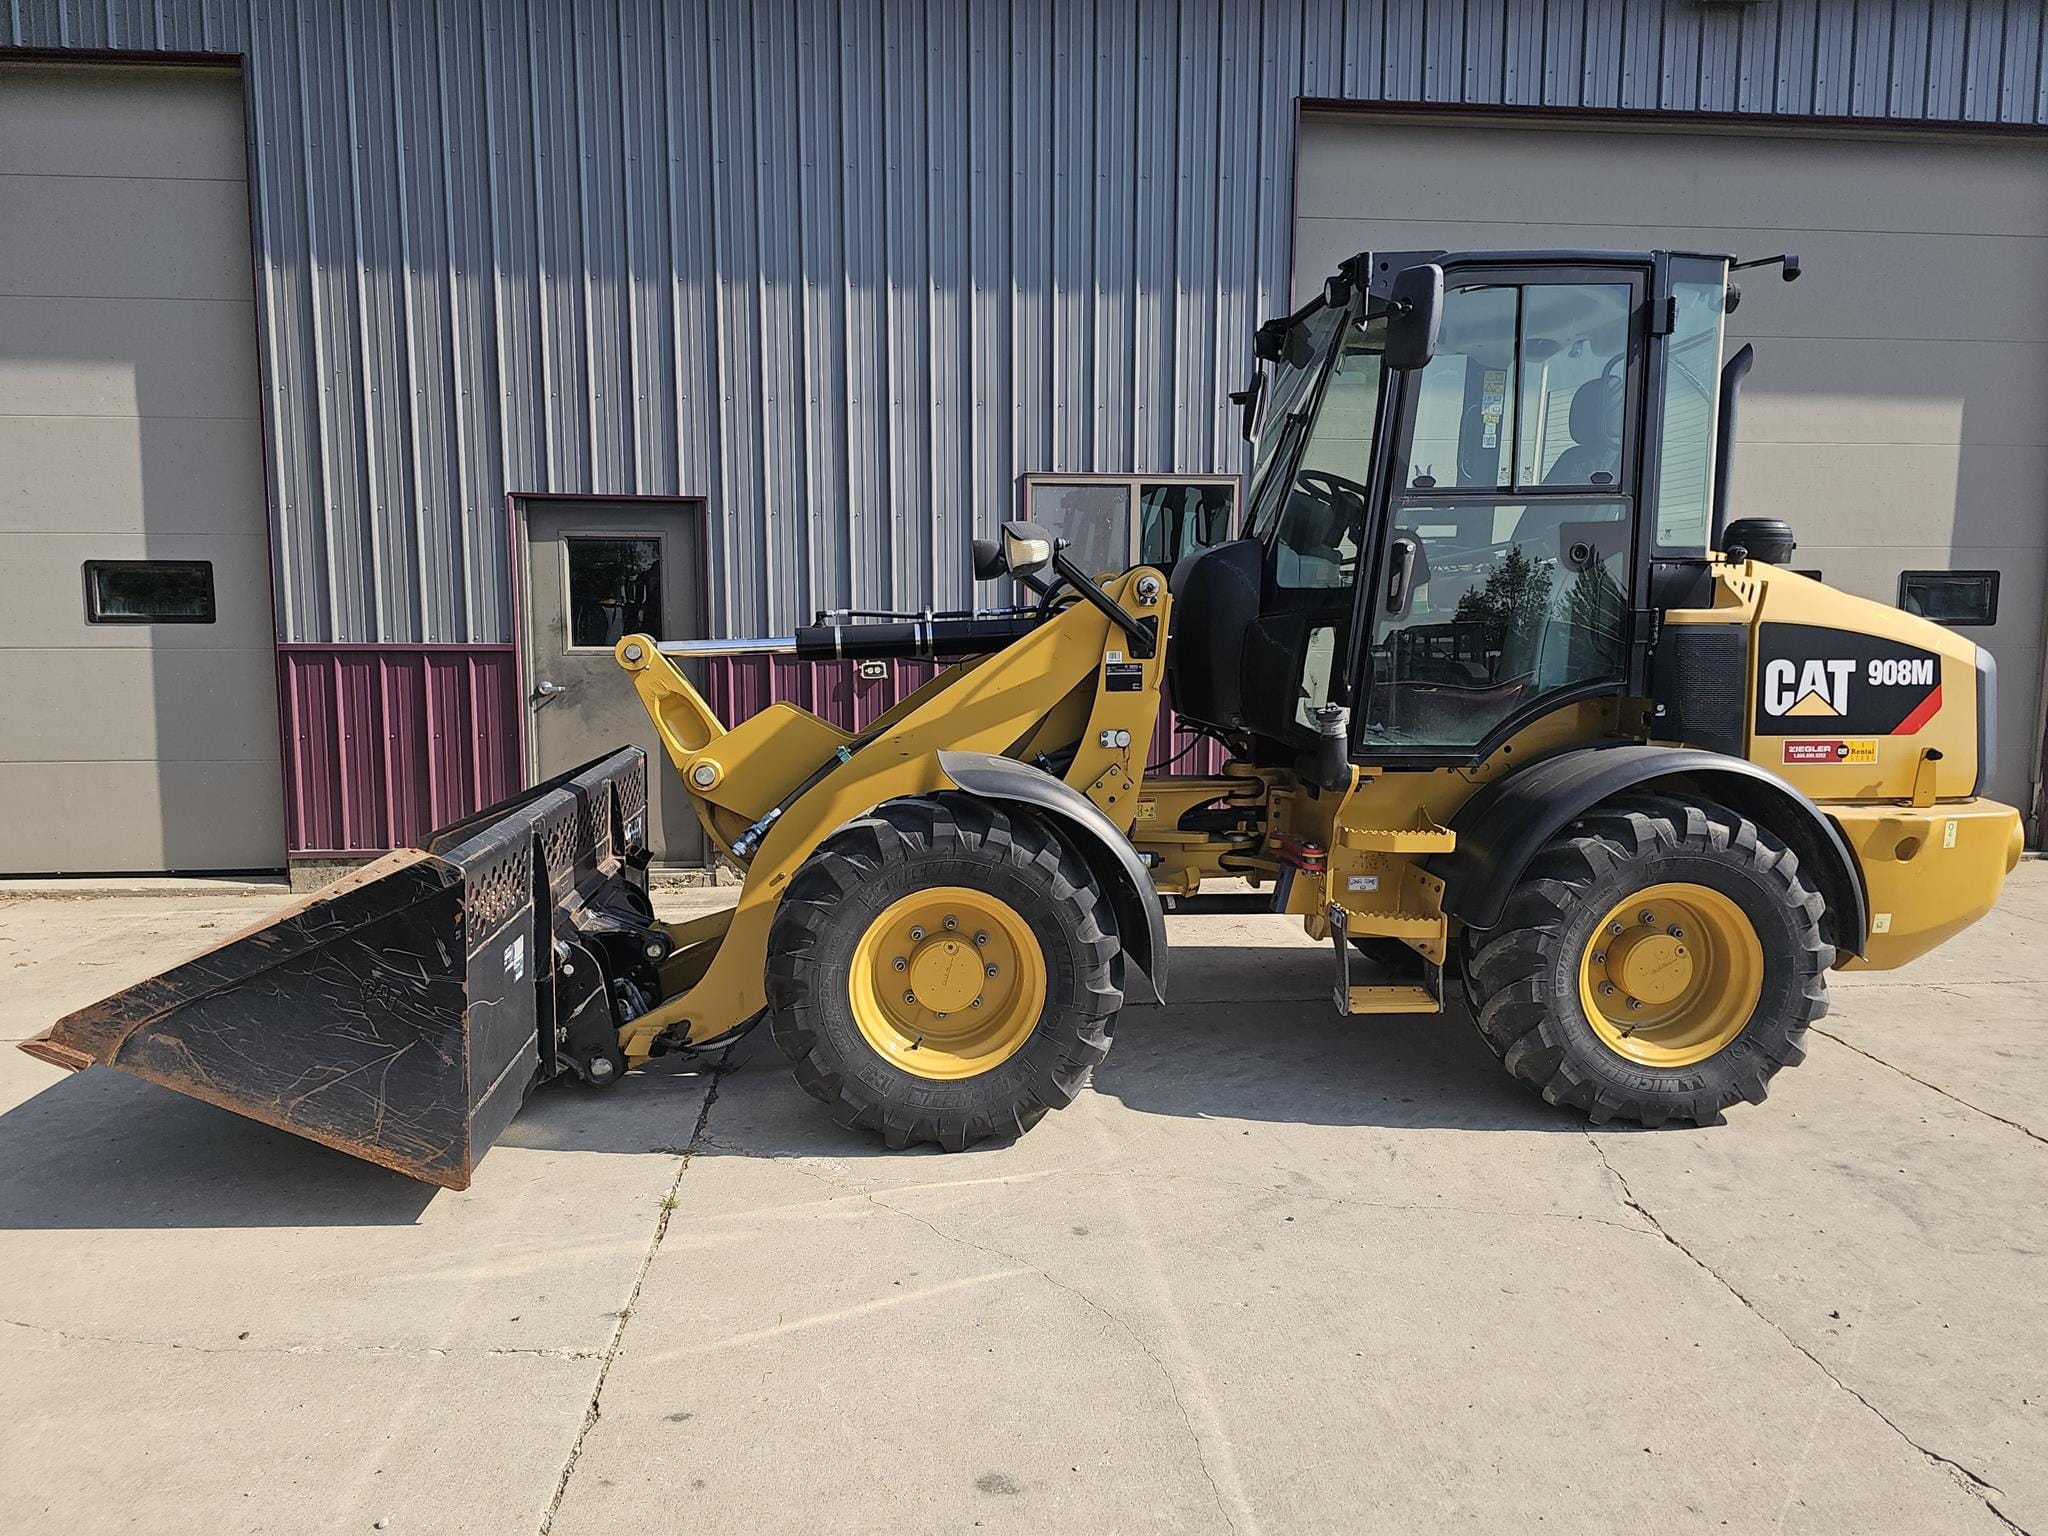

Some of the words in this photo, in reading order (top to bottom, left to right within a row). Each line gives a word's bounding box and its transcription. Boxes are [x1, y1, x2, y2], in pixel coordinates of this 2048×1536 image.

[1764, 659, 1856, 717] CAT
[1868, 659, 1934, 686] 908M
[1788, 745, 1831, 753] ZIEGLER
